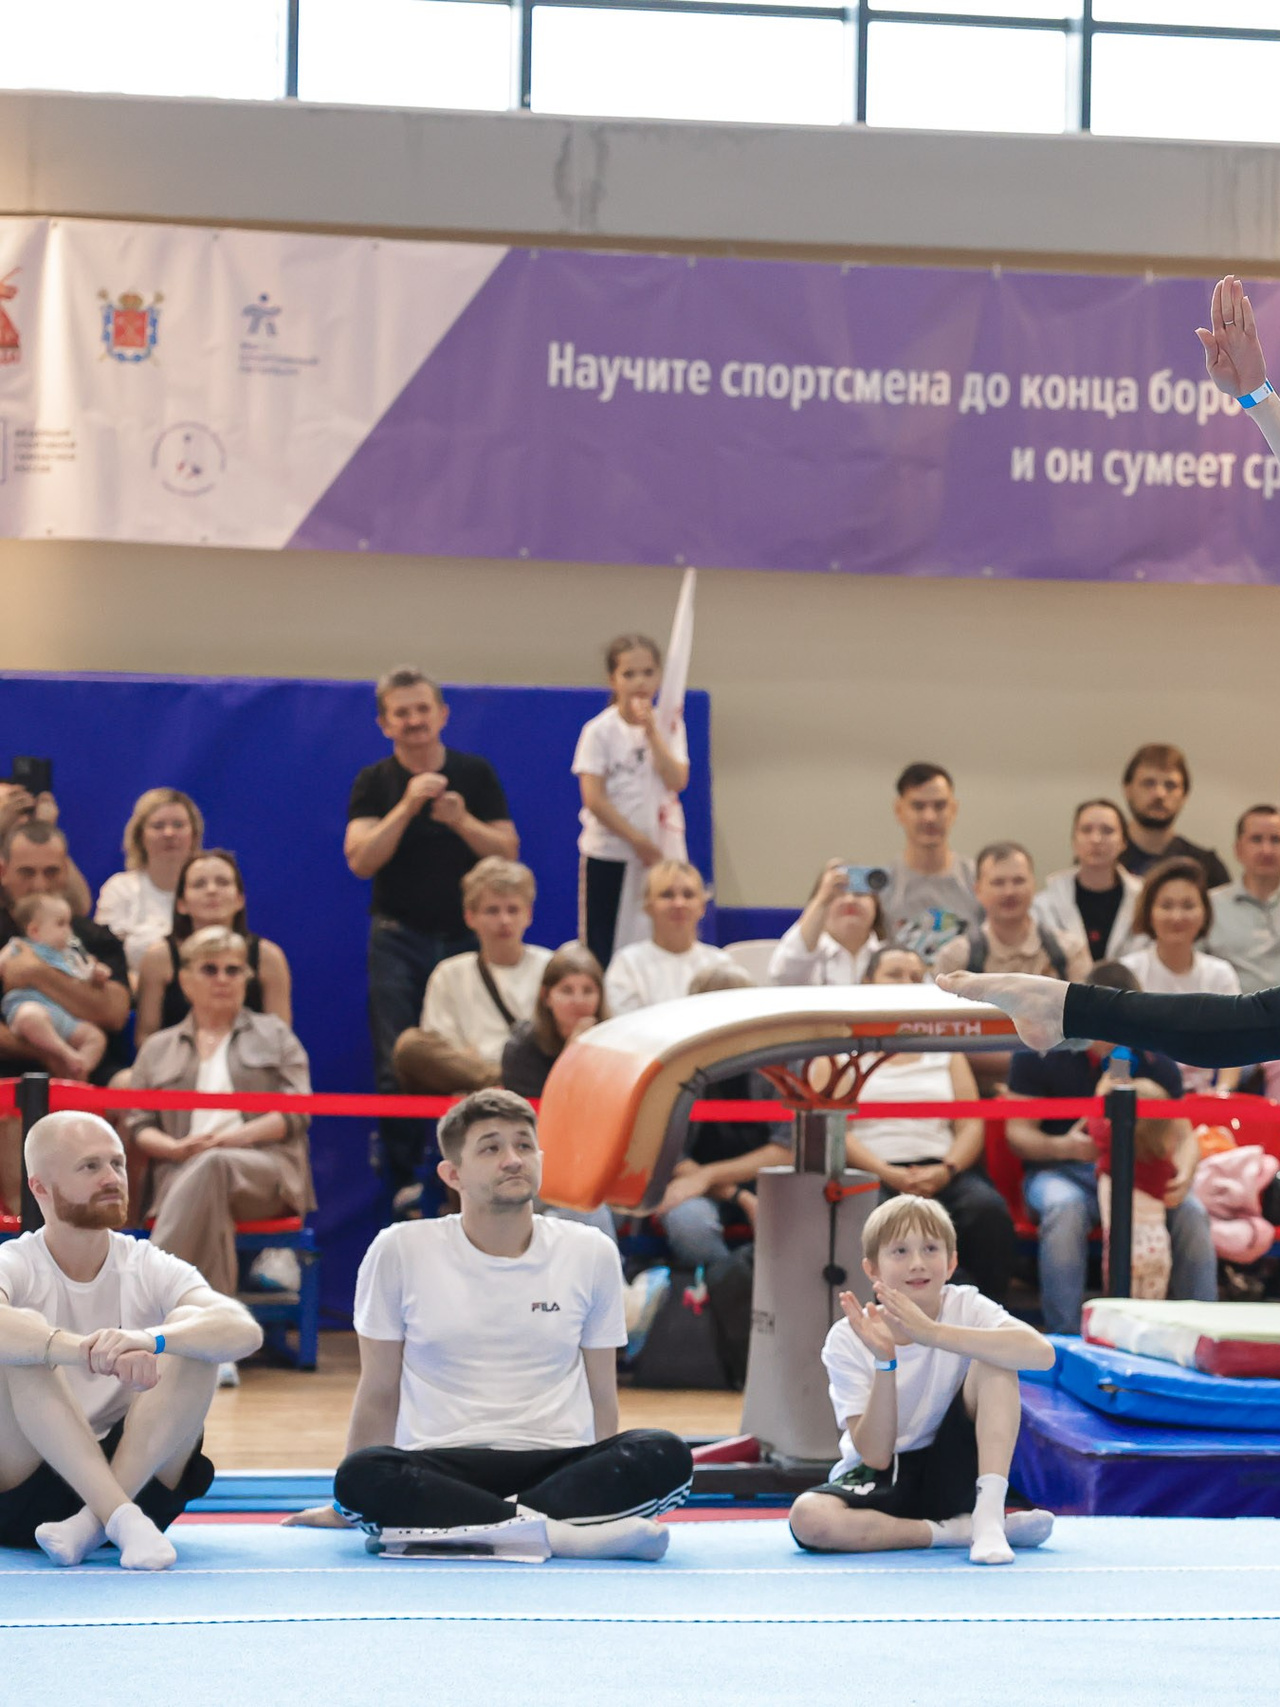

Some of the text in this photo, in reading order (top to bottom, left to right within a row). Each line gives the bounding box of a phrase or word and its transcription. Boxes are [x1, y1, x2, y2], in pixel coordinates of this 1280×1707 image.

[548, 341, 711, 402] Научите
[720, 361, 952, 411] спортсмена
[959, 370, 1010, 414] до
[1019, 374, 1138, 419] конца
[1010, 447, 1036, 482] и
[1044, 447, 1094, 484] он
[1102, 449, 1237, 497] сумеет
[531, 1301, 561, 1312] FILA
